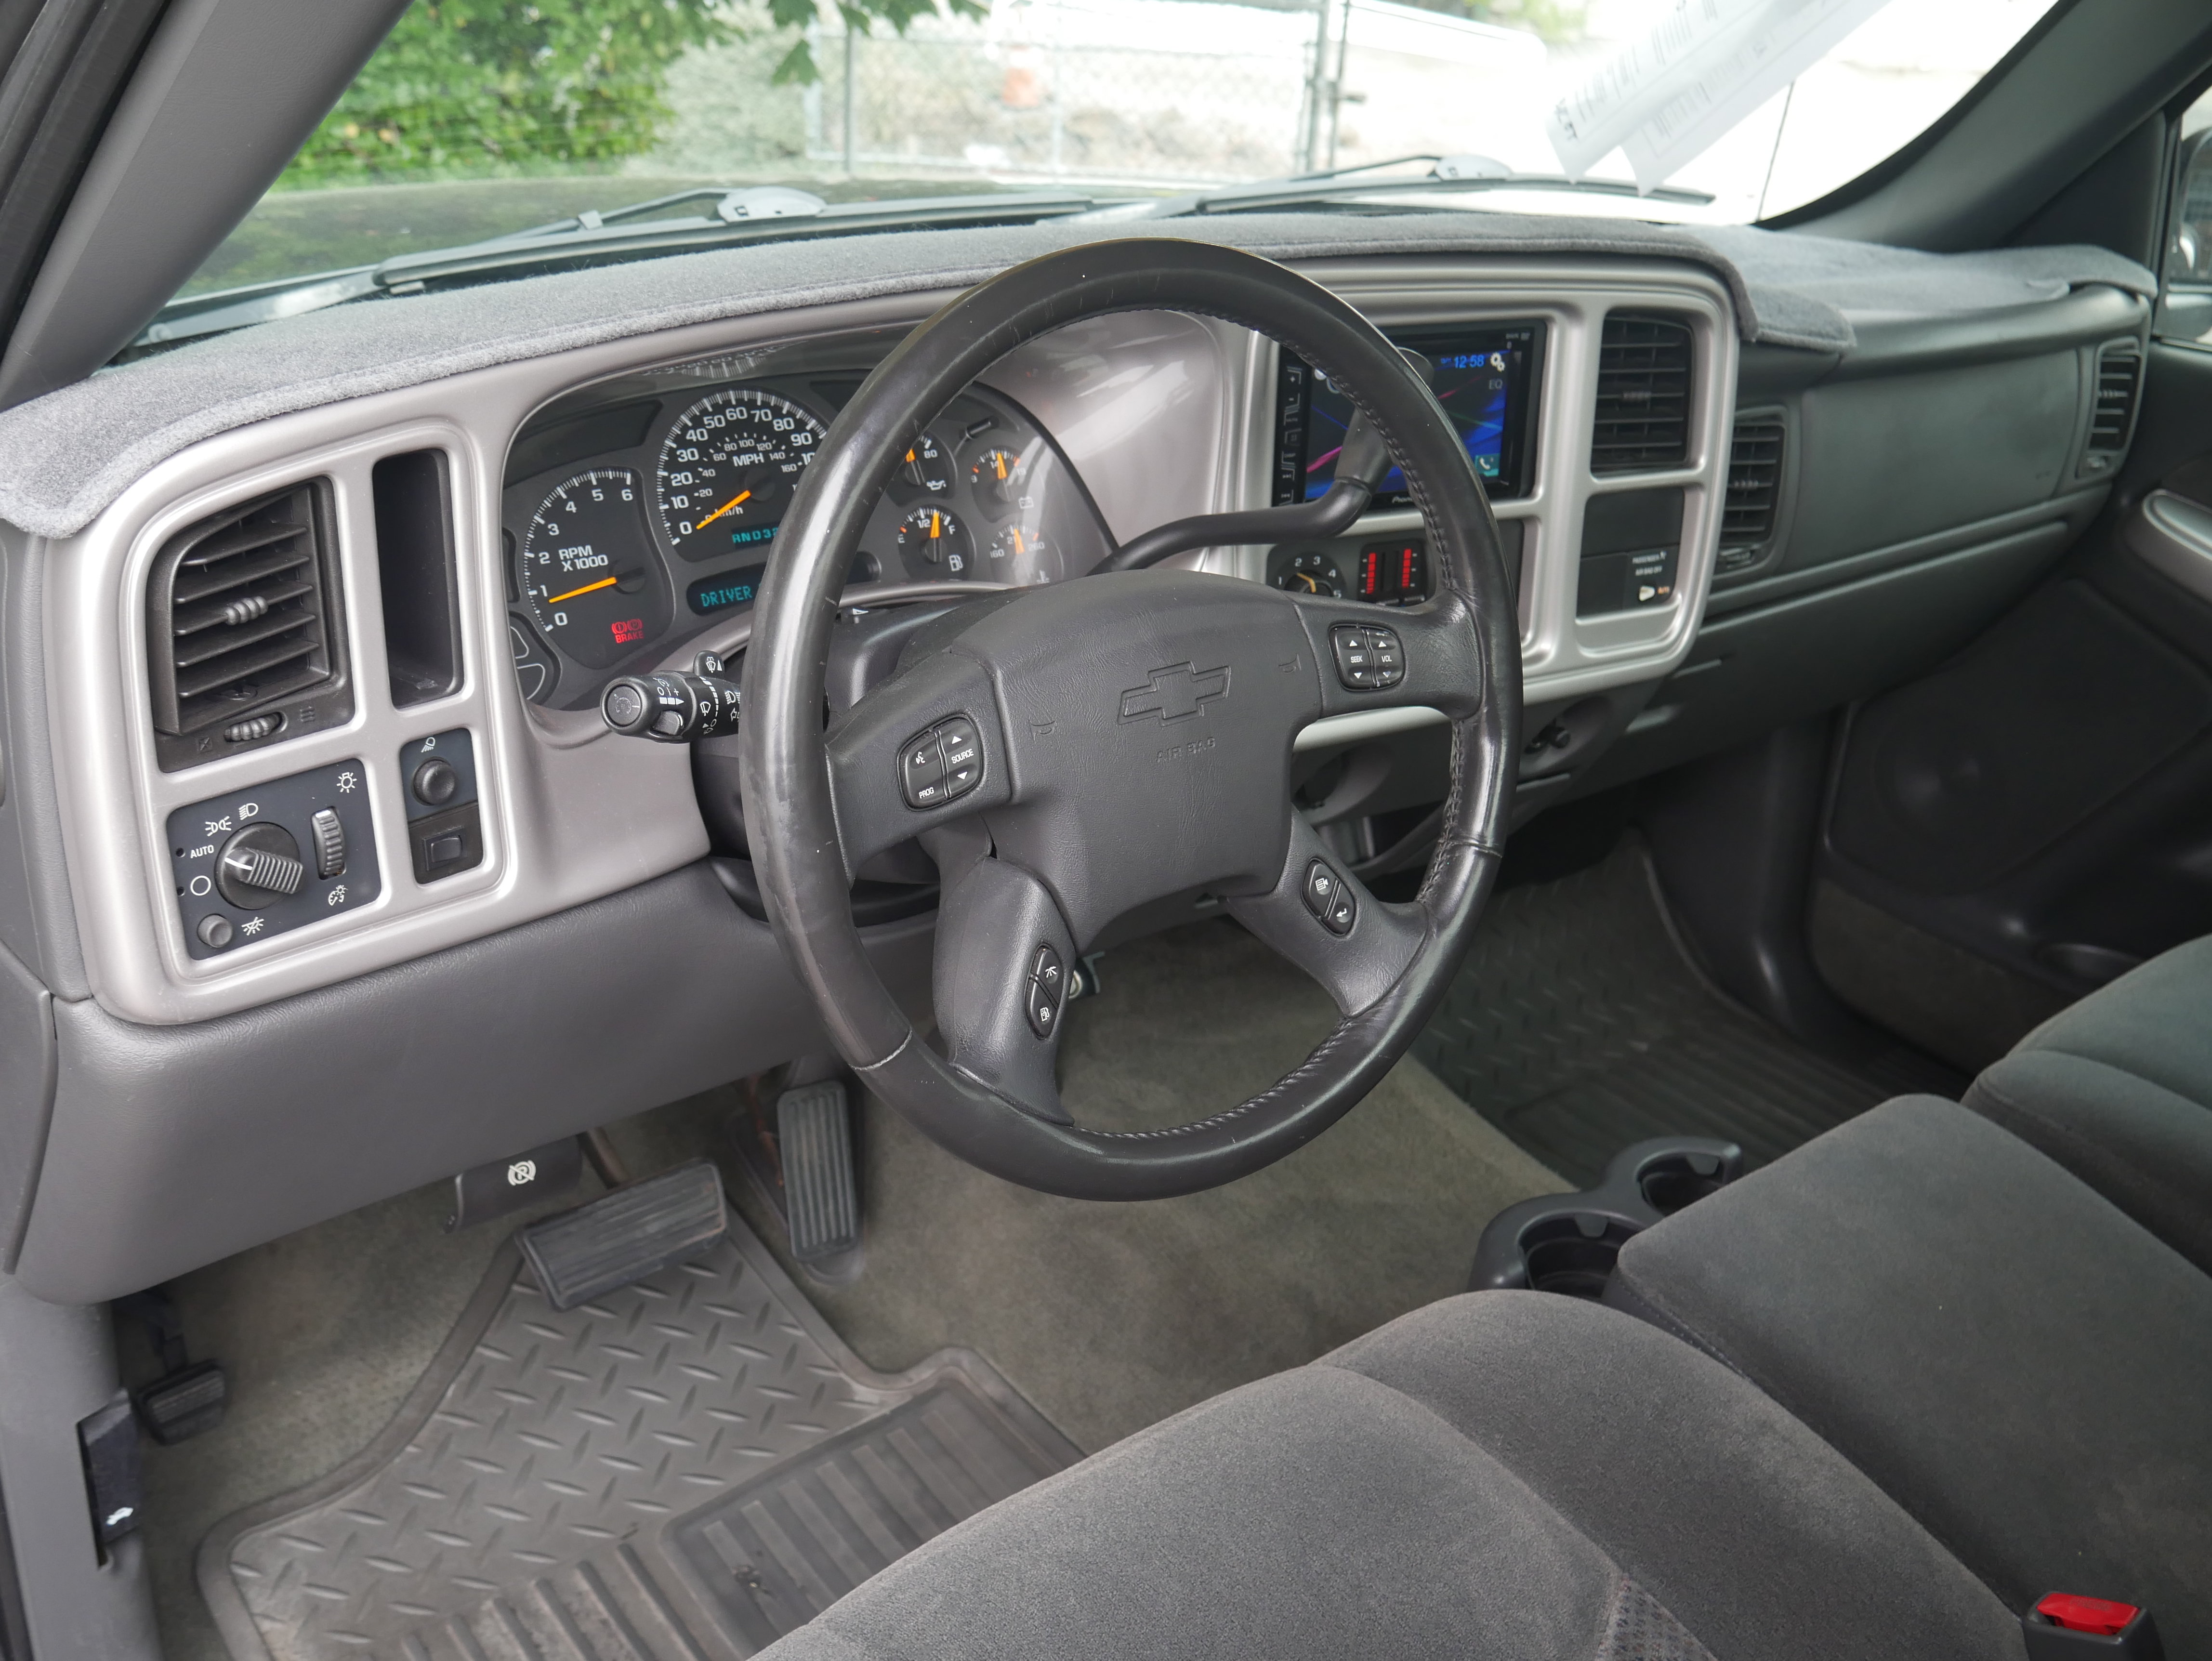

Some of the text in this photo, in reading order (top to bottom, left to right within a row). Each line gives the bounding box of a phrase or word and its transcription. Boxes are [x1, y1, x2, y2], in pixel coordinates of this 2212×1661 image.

[1488, 379, 1503, 391] EQ
[725, 407, 748, 421] 60
[750, 409, 772, 422] 70
[703, 415, 726, 429] 50
[773, 417, 795, 431] 80
[686, 428, 709, 442] 40
[790, 432, 813, 446] 90
[724, 442, 737, 451] 80
[738, 439, 755, 448] 100
[756, 442, 773, 451] 120
[676, 448, 699, 462] 30
[713, 452, 727, 461] 60
[732, 452, 764, 467] MPH
[769, 451, 786, 461] 140
[924, 449, 938, 458] 80
[702, 469, 716, 477] 40
[781, 464, 797, 473] 160
[671, 472, 693, 487] 20
[592, 489, 604, 501] 5
[622, 489, 633, 501] 6
[699, 488, 713, 497] 20
[565, 501, 577, 513] 4
[671, 495, 689, 509] 10
[548, 524, 559, 535] 3
[679, 521, 692, 534] 0
[948, 525, 956, 534] F
[898, 535, 905, 543] E
[558, 545, 593, 560] RPM
[1028, 541, 1045, 552] 260
[539, 552, 550, 564] 2
[990, 549, 1005, 558] 160
[1295, 557, 1302, 567] 2
[1313, 555, 1321, 566] 3
[1328, 569, 1336, 578] 4
[1278, 577, 1282, 585] 1
[540, 585, 547, 597] 1
[701, 585, 752, 606] DRIVER
[554, 612, 568, 626] 0
[615, 631, 644, 643] BRAKE
[951, 748, 974, 764] SOURCE
[1157, 737, 1216, 763] AIR BAG
[919, 787, 935, 799] PROG
[190, 844, 214, 858] AUTO
